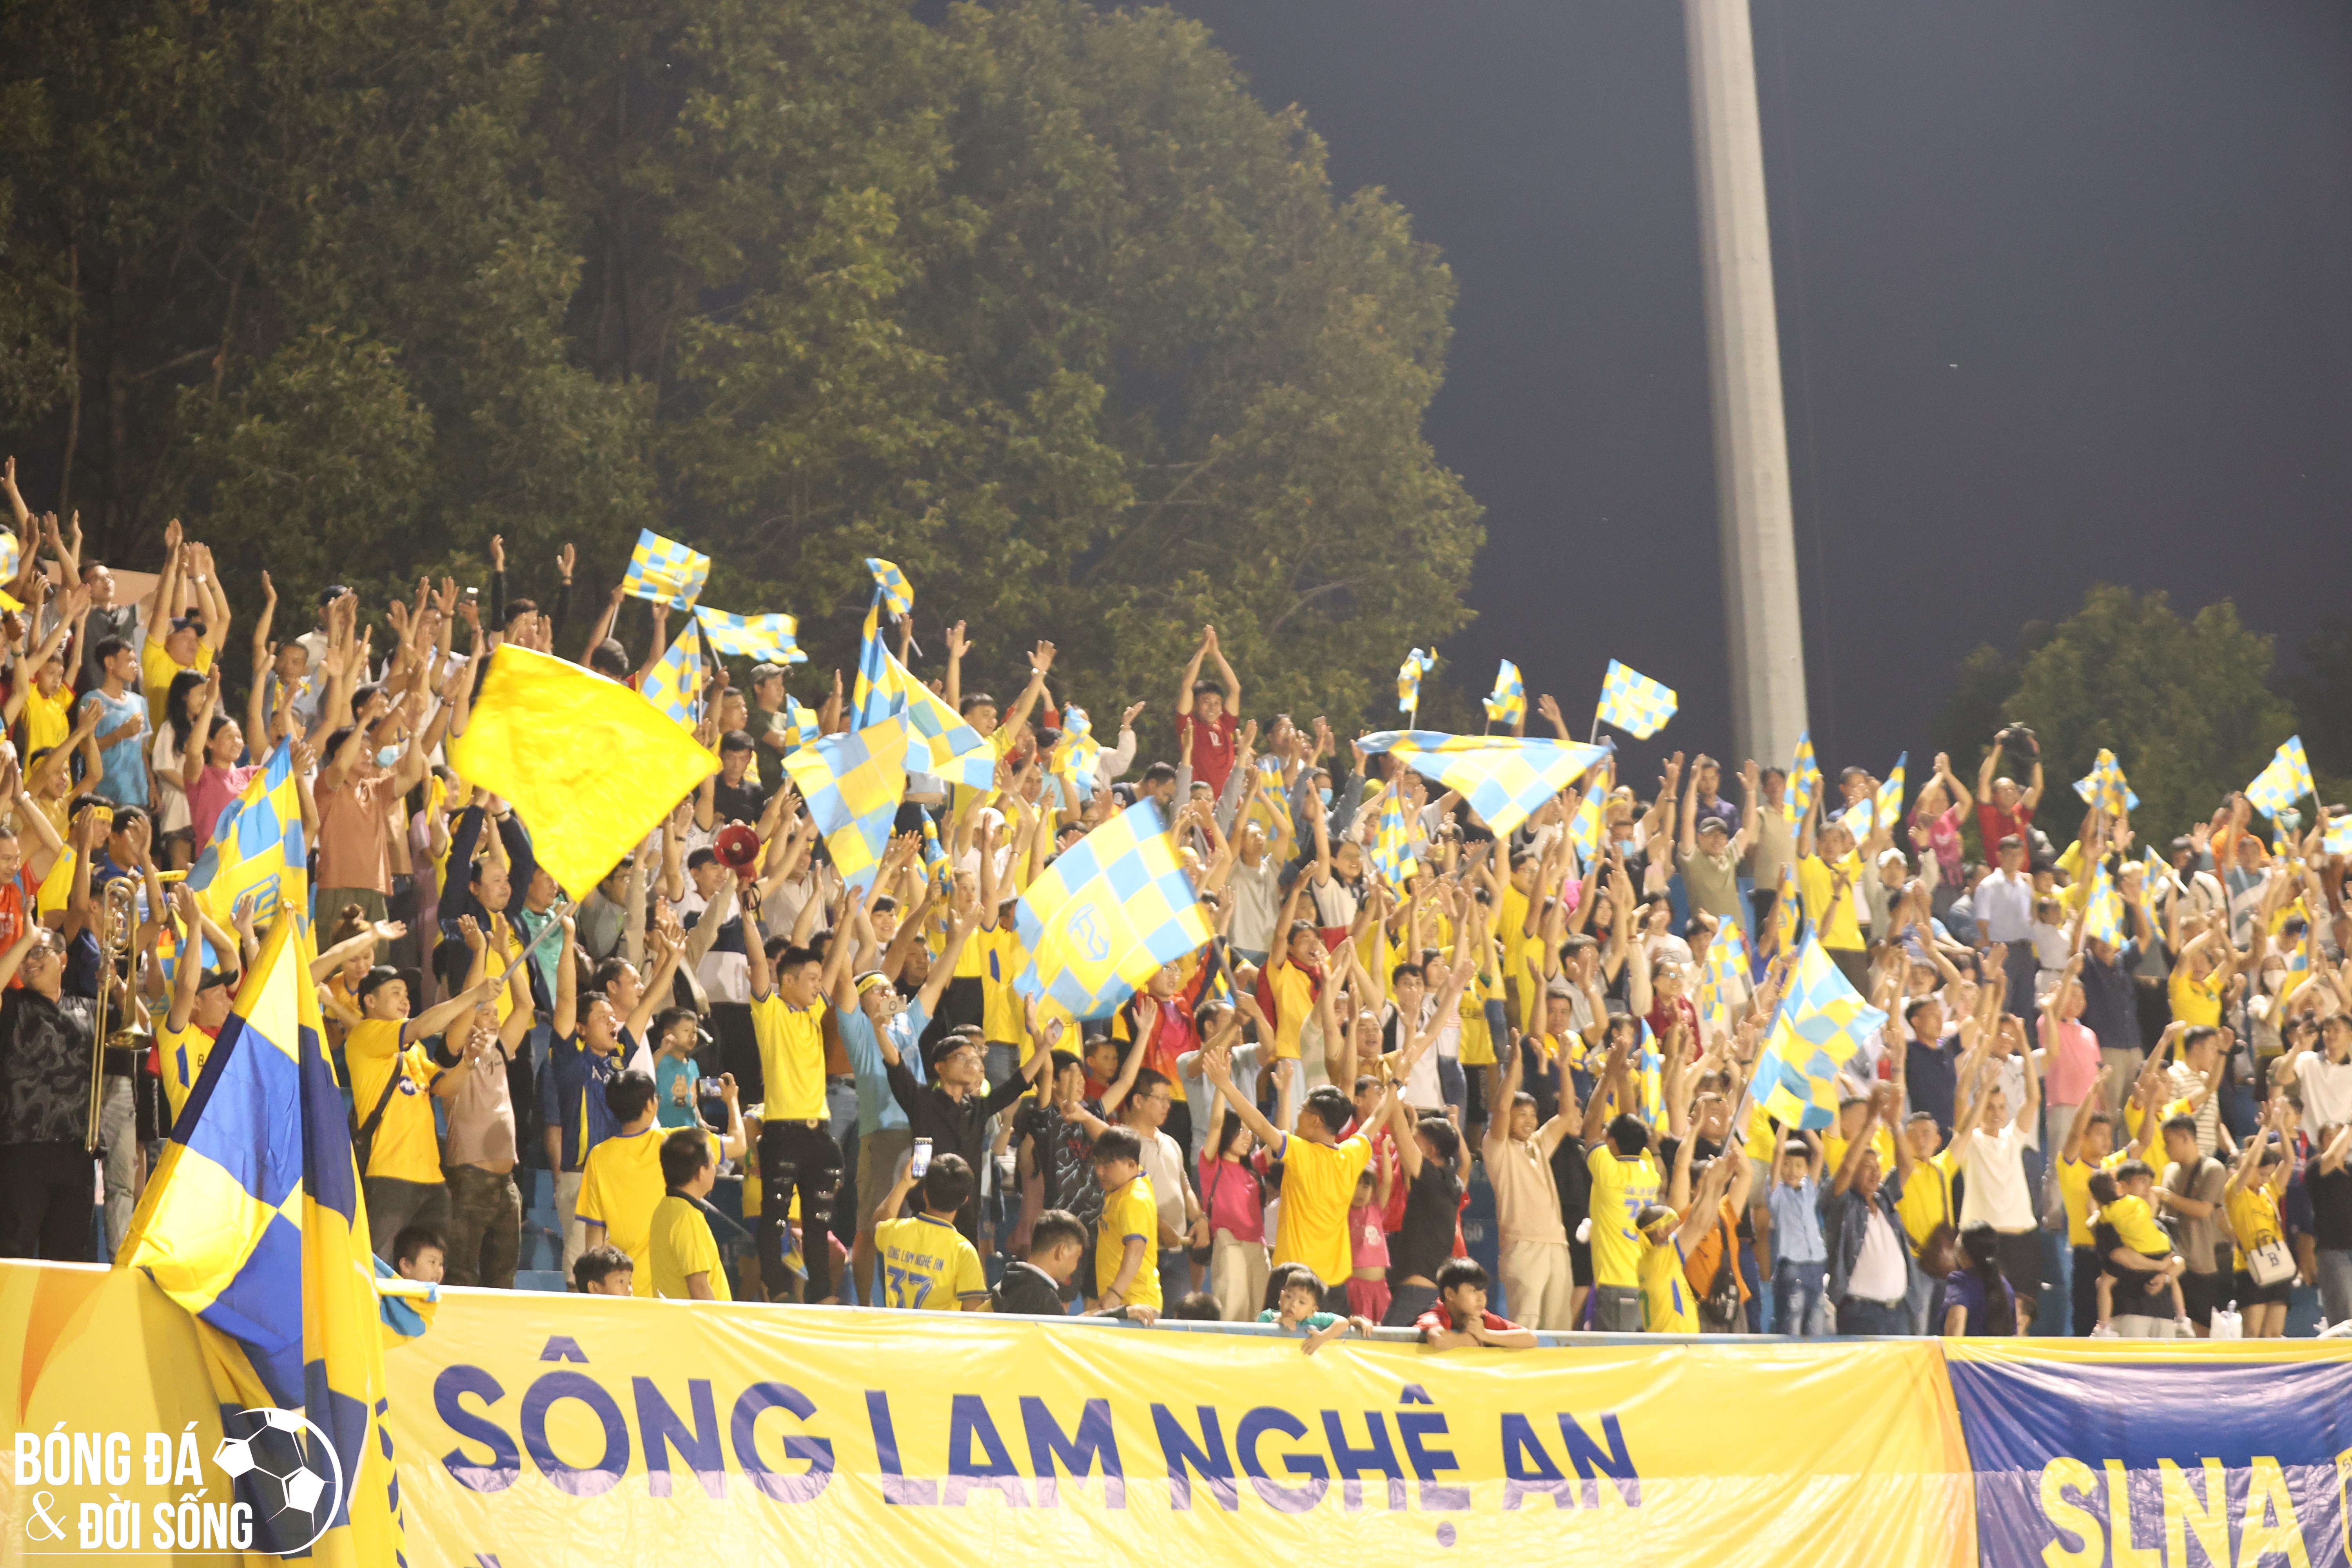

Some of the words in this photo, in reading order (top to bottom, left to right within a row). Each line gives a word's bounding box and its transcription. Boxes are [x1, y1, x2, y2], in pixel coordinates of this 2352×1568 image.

[886, 1265, 934, 1309] 37
[434, 1336, 835, 1504] SÔNG
[865, 1390, 1126, 1509] LAM
[1151, 1385, 1471, 1548] NGHỆ
[1501, 1412, 1642, 1509] AN
[2040, 1455, 2311, 1568] SLNA
